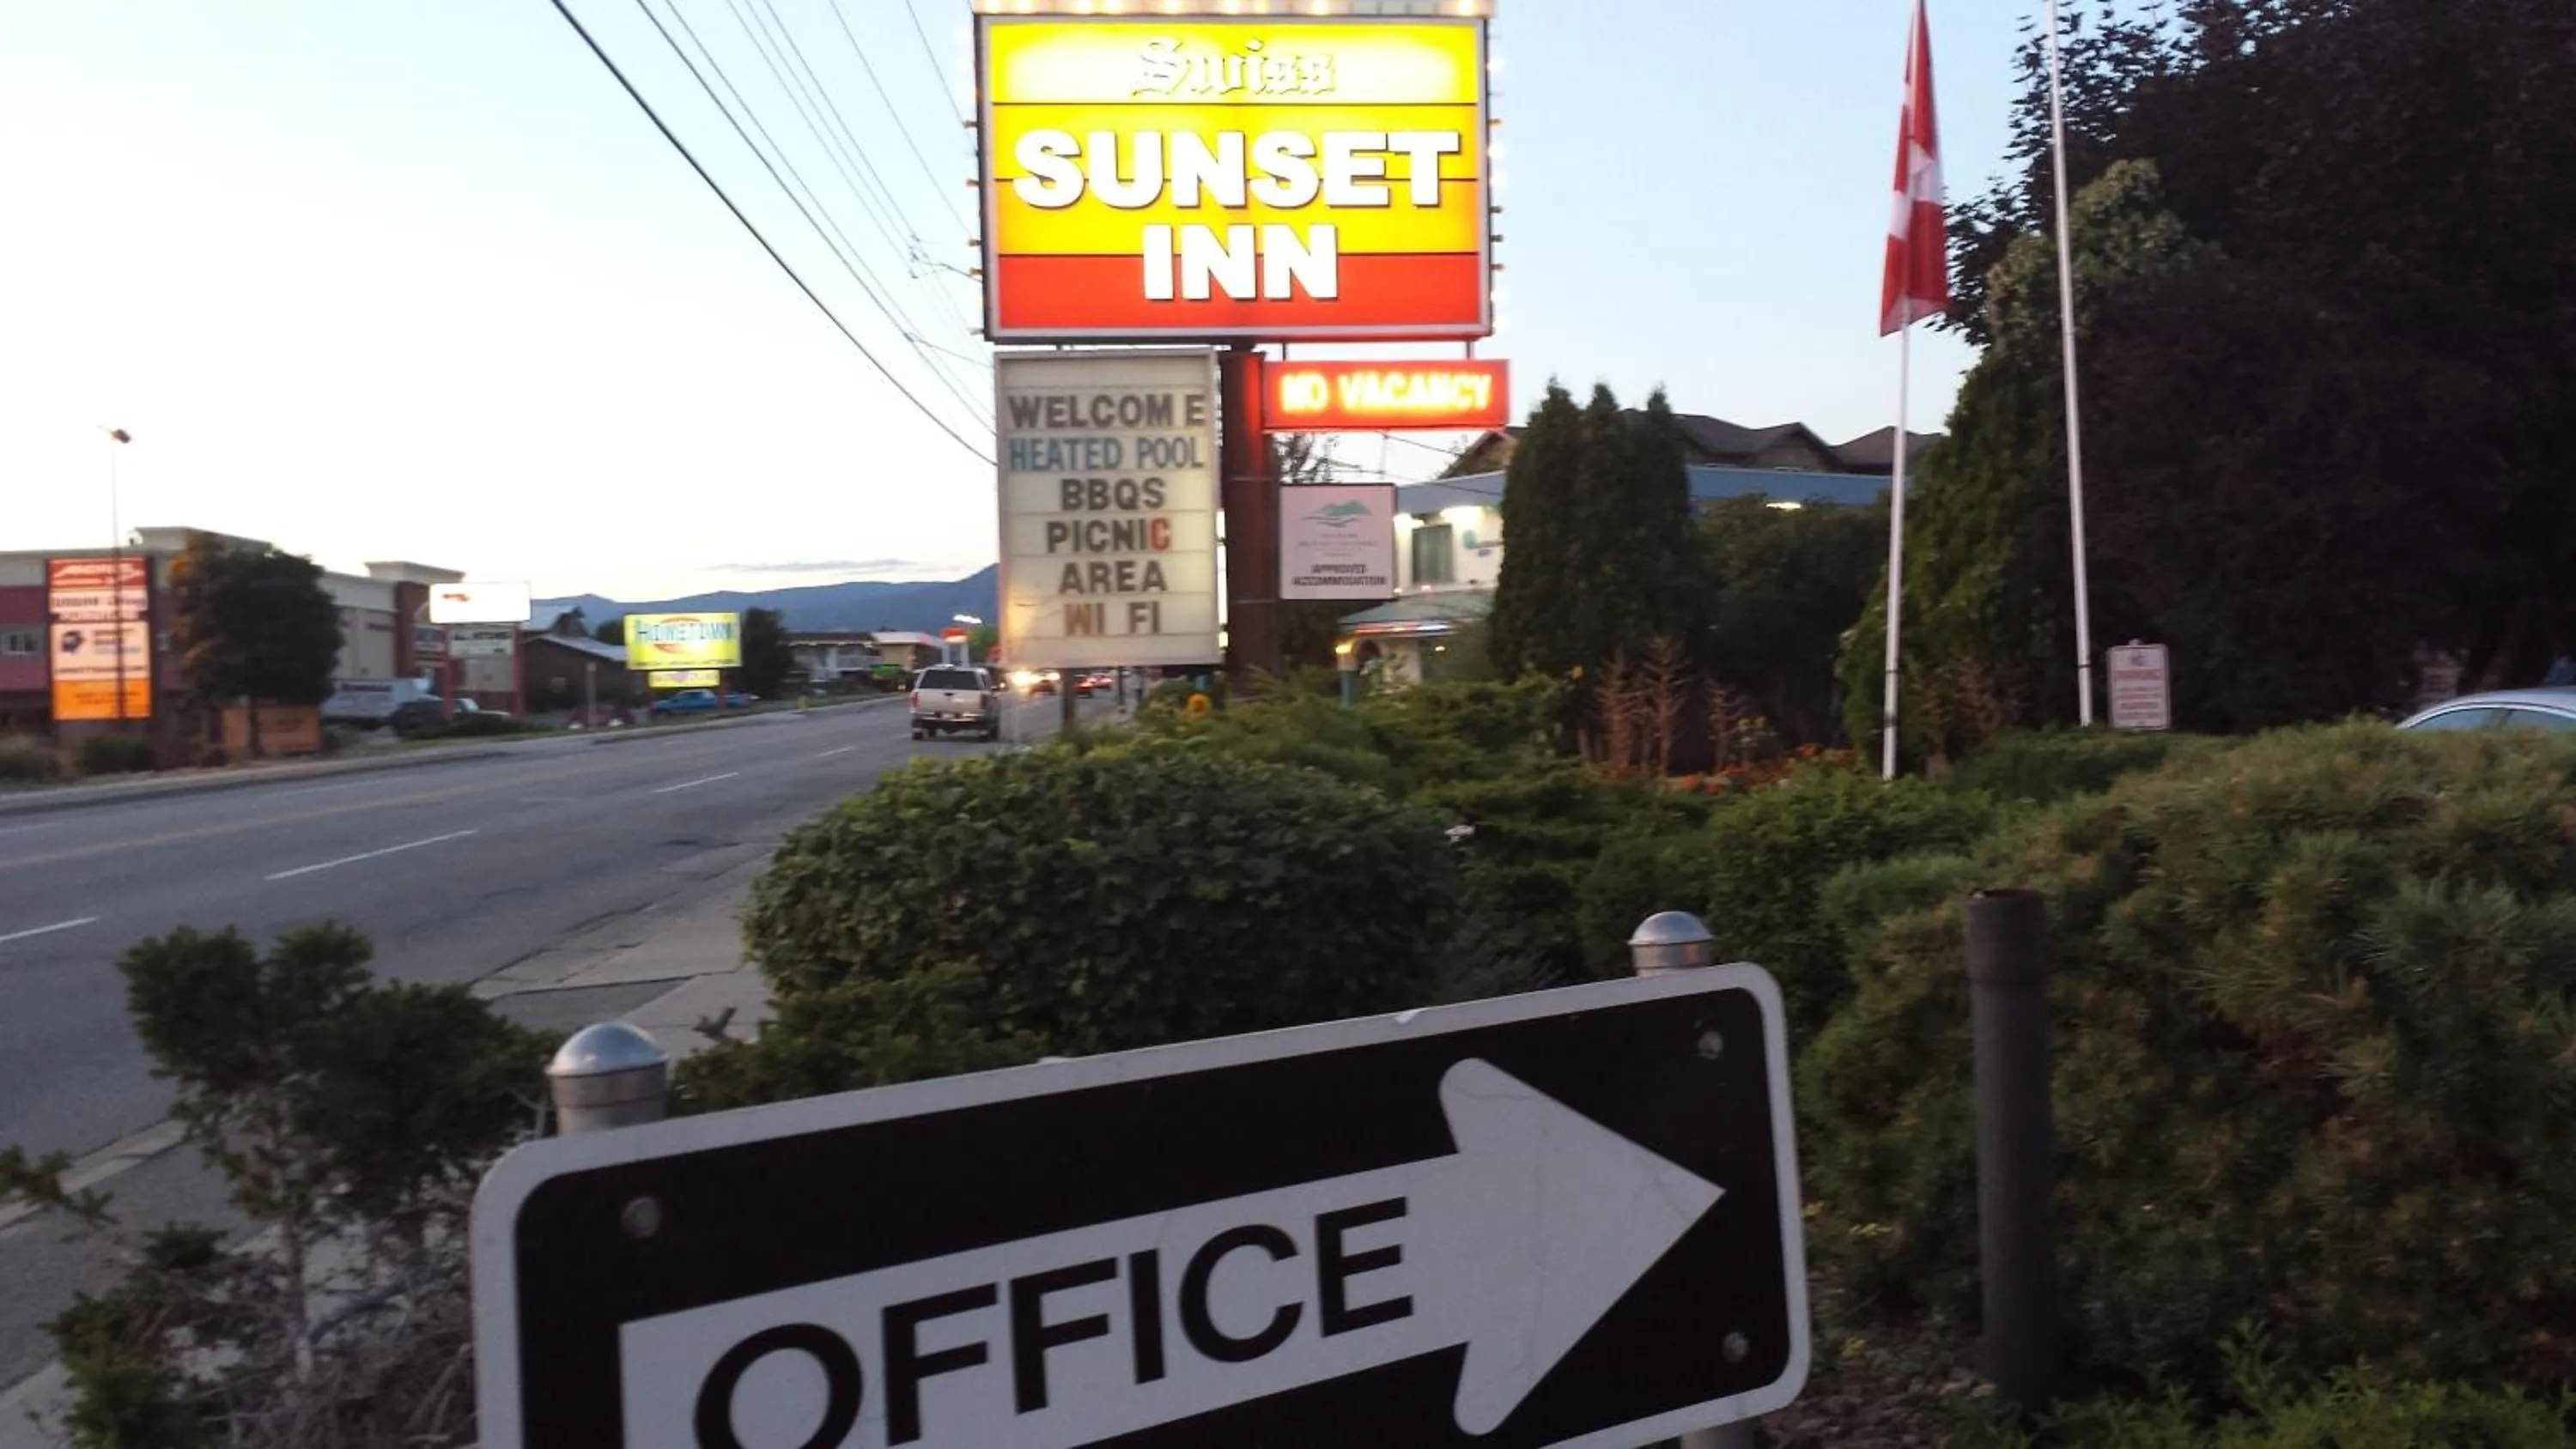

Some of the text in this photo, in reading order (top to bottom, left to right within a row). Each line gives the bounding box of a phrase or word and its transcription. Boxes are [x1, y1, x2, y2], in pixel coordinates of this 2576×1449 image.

[1131, 37, 1336, 96] Swiss
[1012, 130, 1461, 209] SUNSET
[1142, 223, 1339, 301] INN
[1279, 371, 1492, 412] NO VACANCY
[1007, 394, 1206, 428] WELCOME
[1009, 436, 1204, 471] HEATED POOL
[1060, 477, 1167, 512] BBQS
[1046, 517, 1172, 554] PICNIC
[1058, 561, 1169, 595] AREA
[1064, 600, 1160, 637] WI FI
[694, 1195, 1413, 1449] OFFICE
